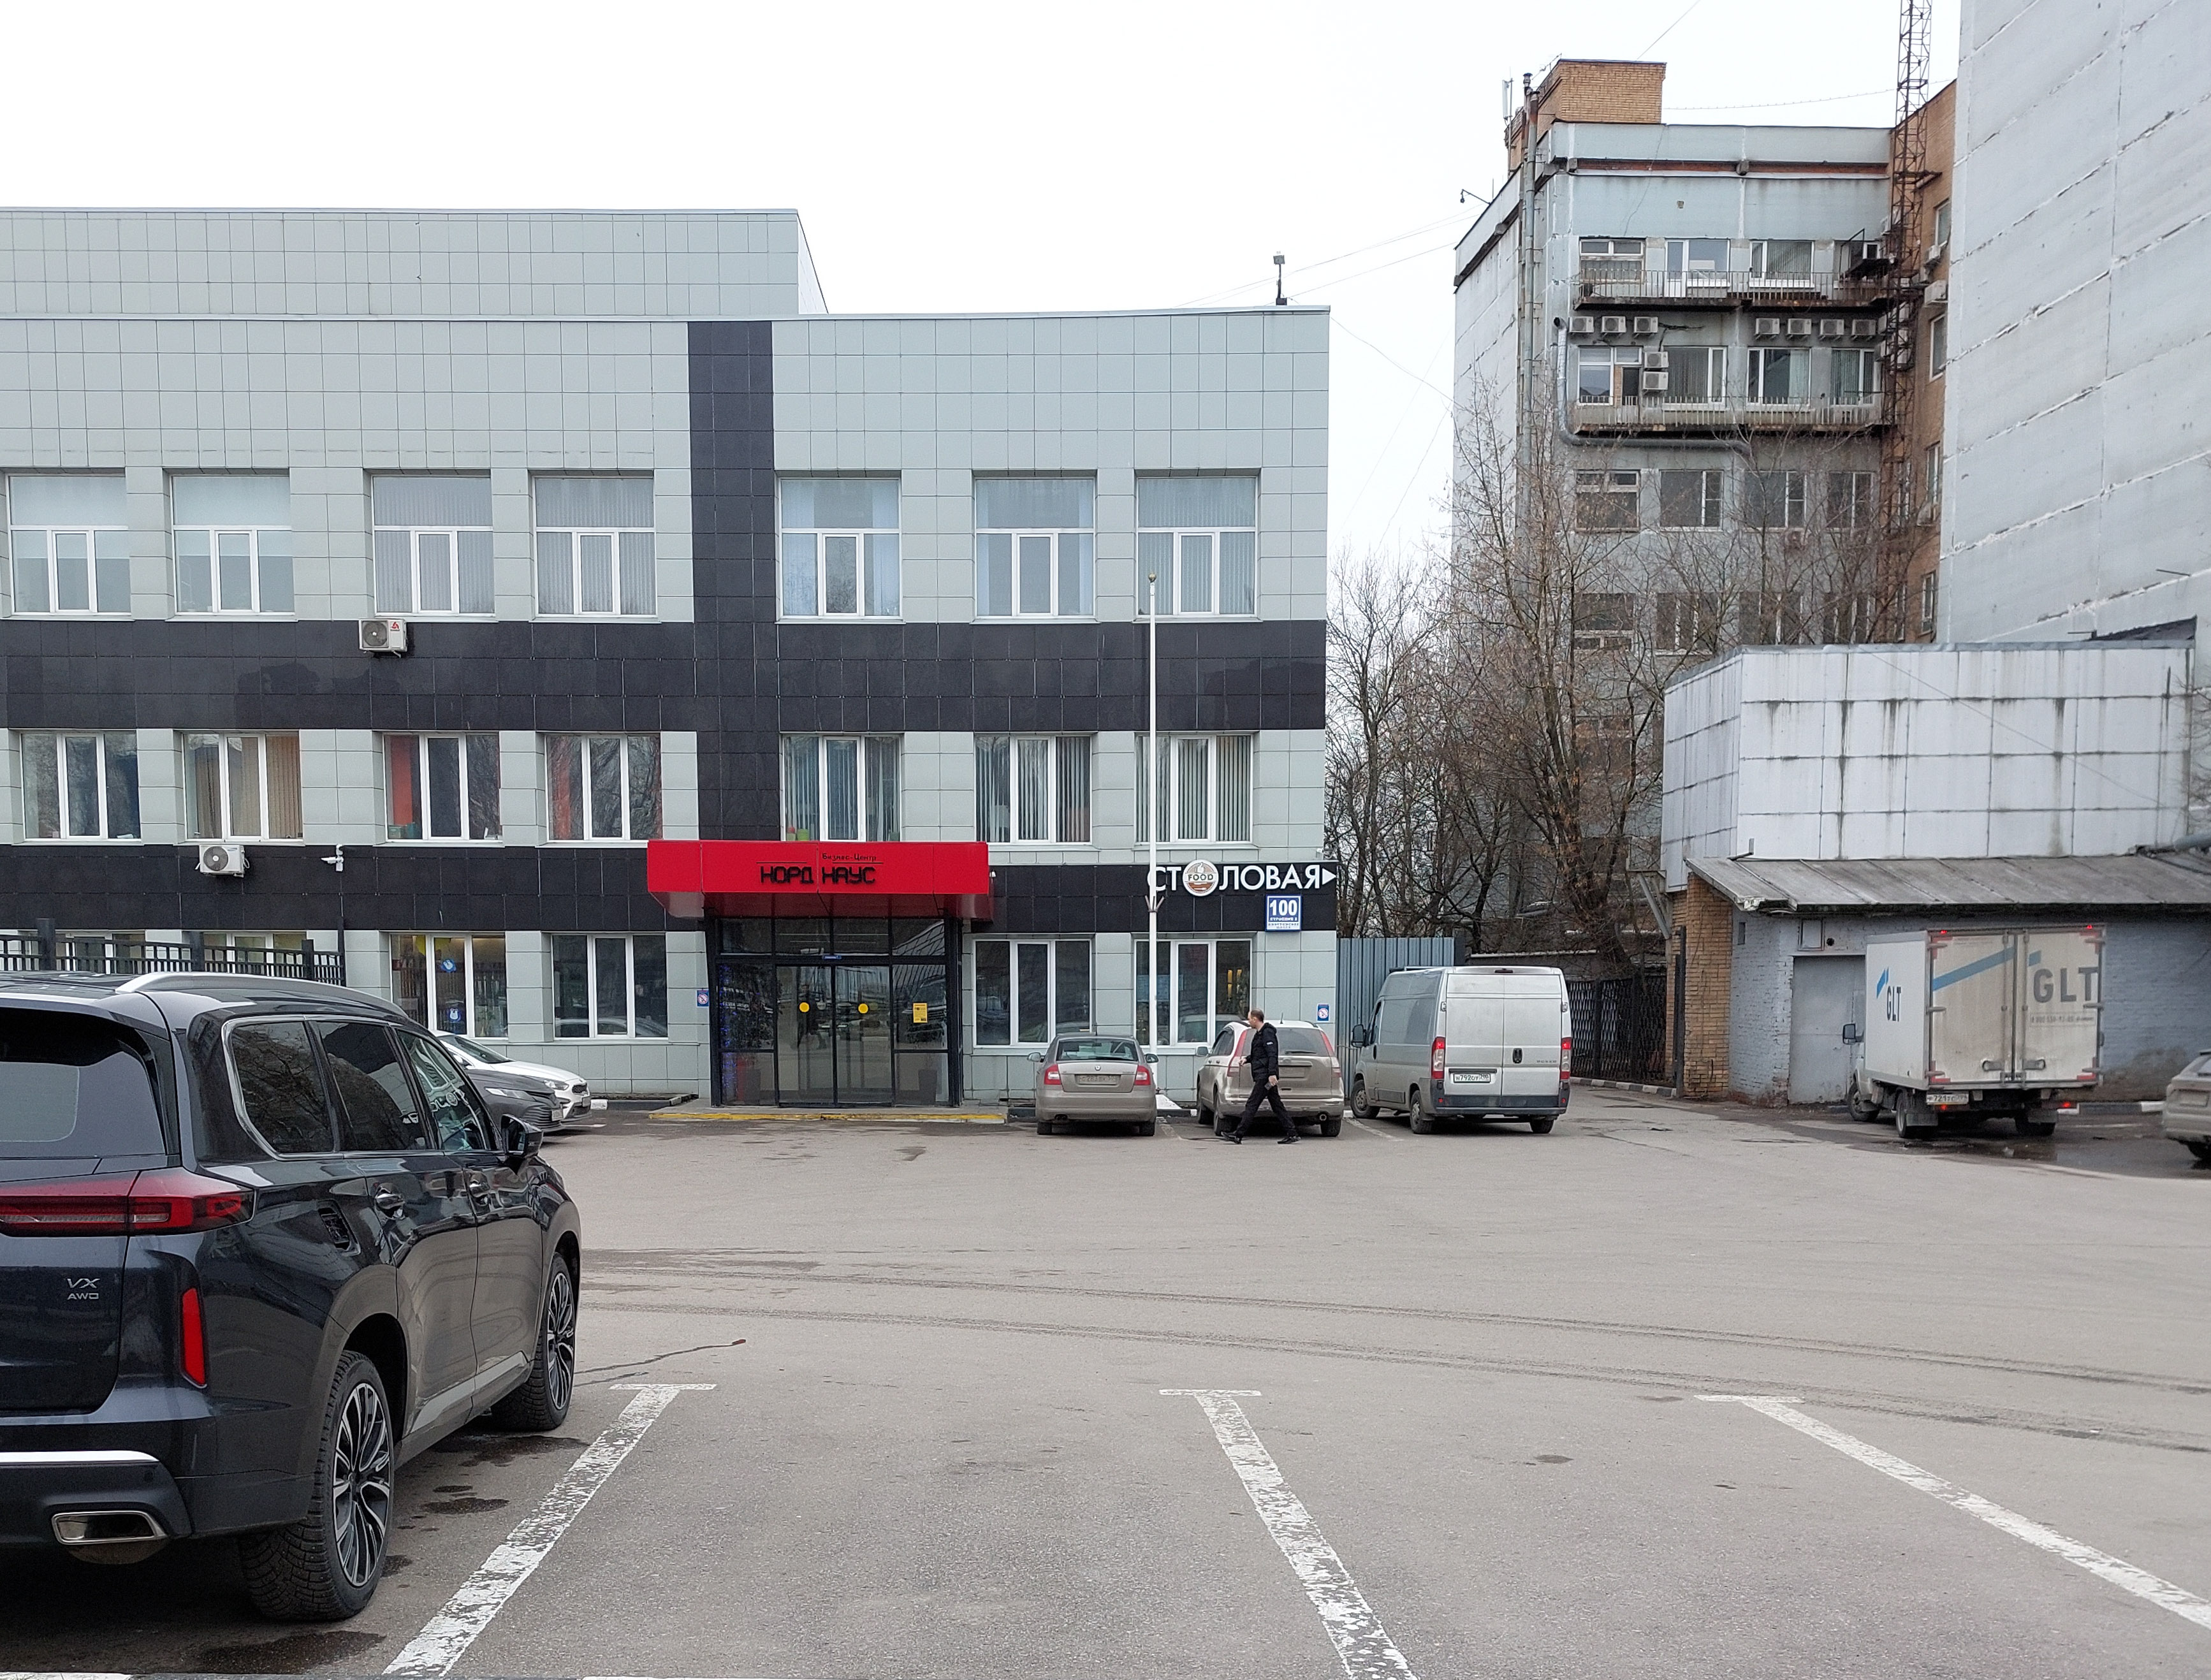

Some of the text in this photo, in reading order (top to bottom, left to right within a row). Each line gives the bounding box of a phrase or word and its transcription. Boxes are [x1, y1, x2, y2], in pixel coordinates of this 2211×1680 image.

[822, 852, 877, 862] Бизнес-Центр
[760, 866, 814, 884] НОРД
[1269, 899, 1297, 916] 100
[2034, 967, 2099, 1003] GLT
[1886, 986, 1902, 1022] GLT
[66, 1278, 101, 1289] VX
